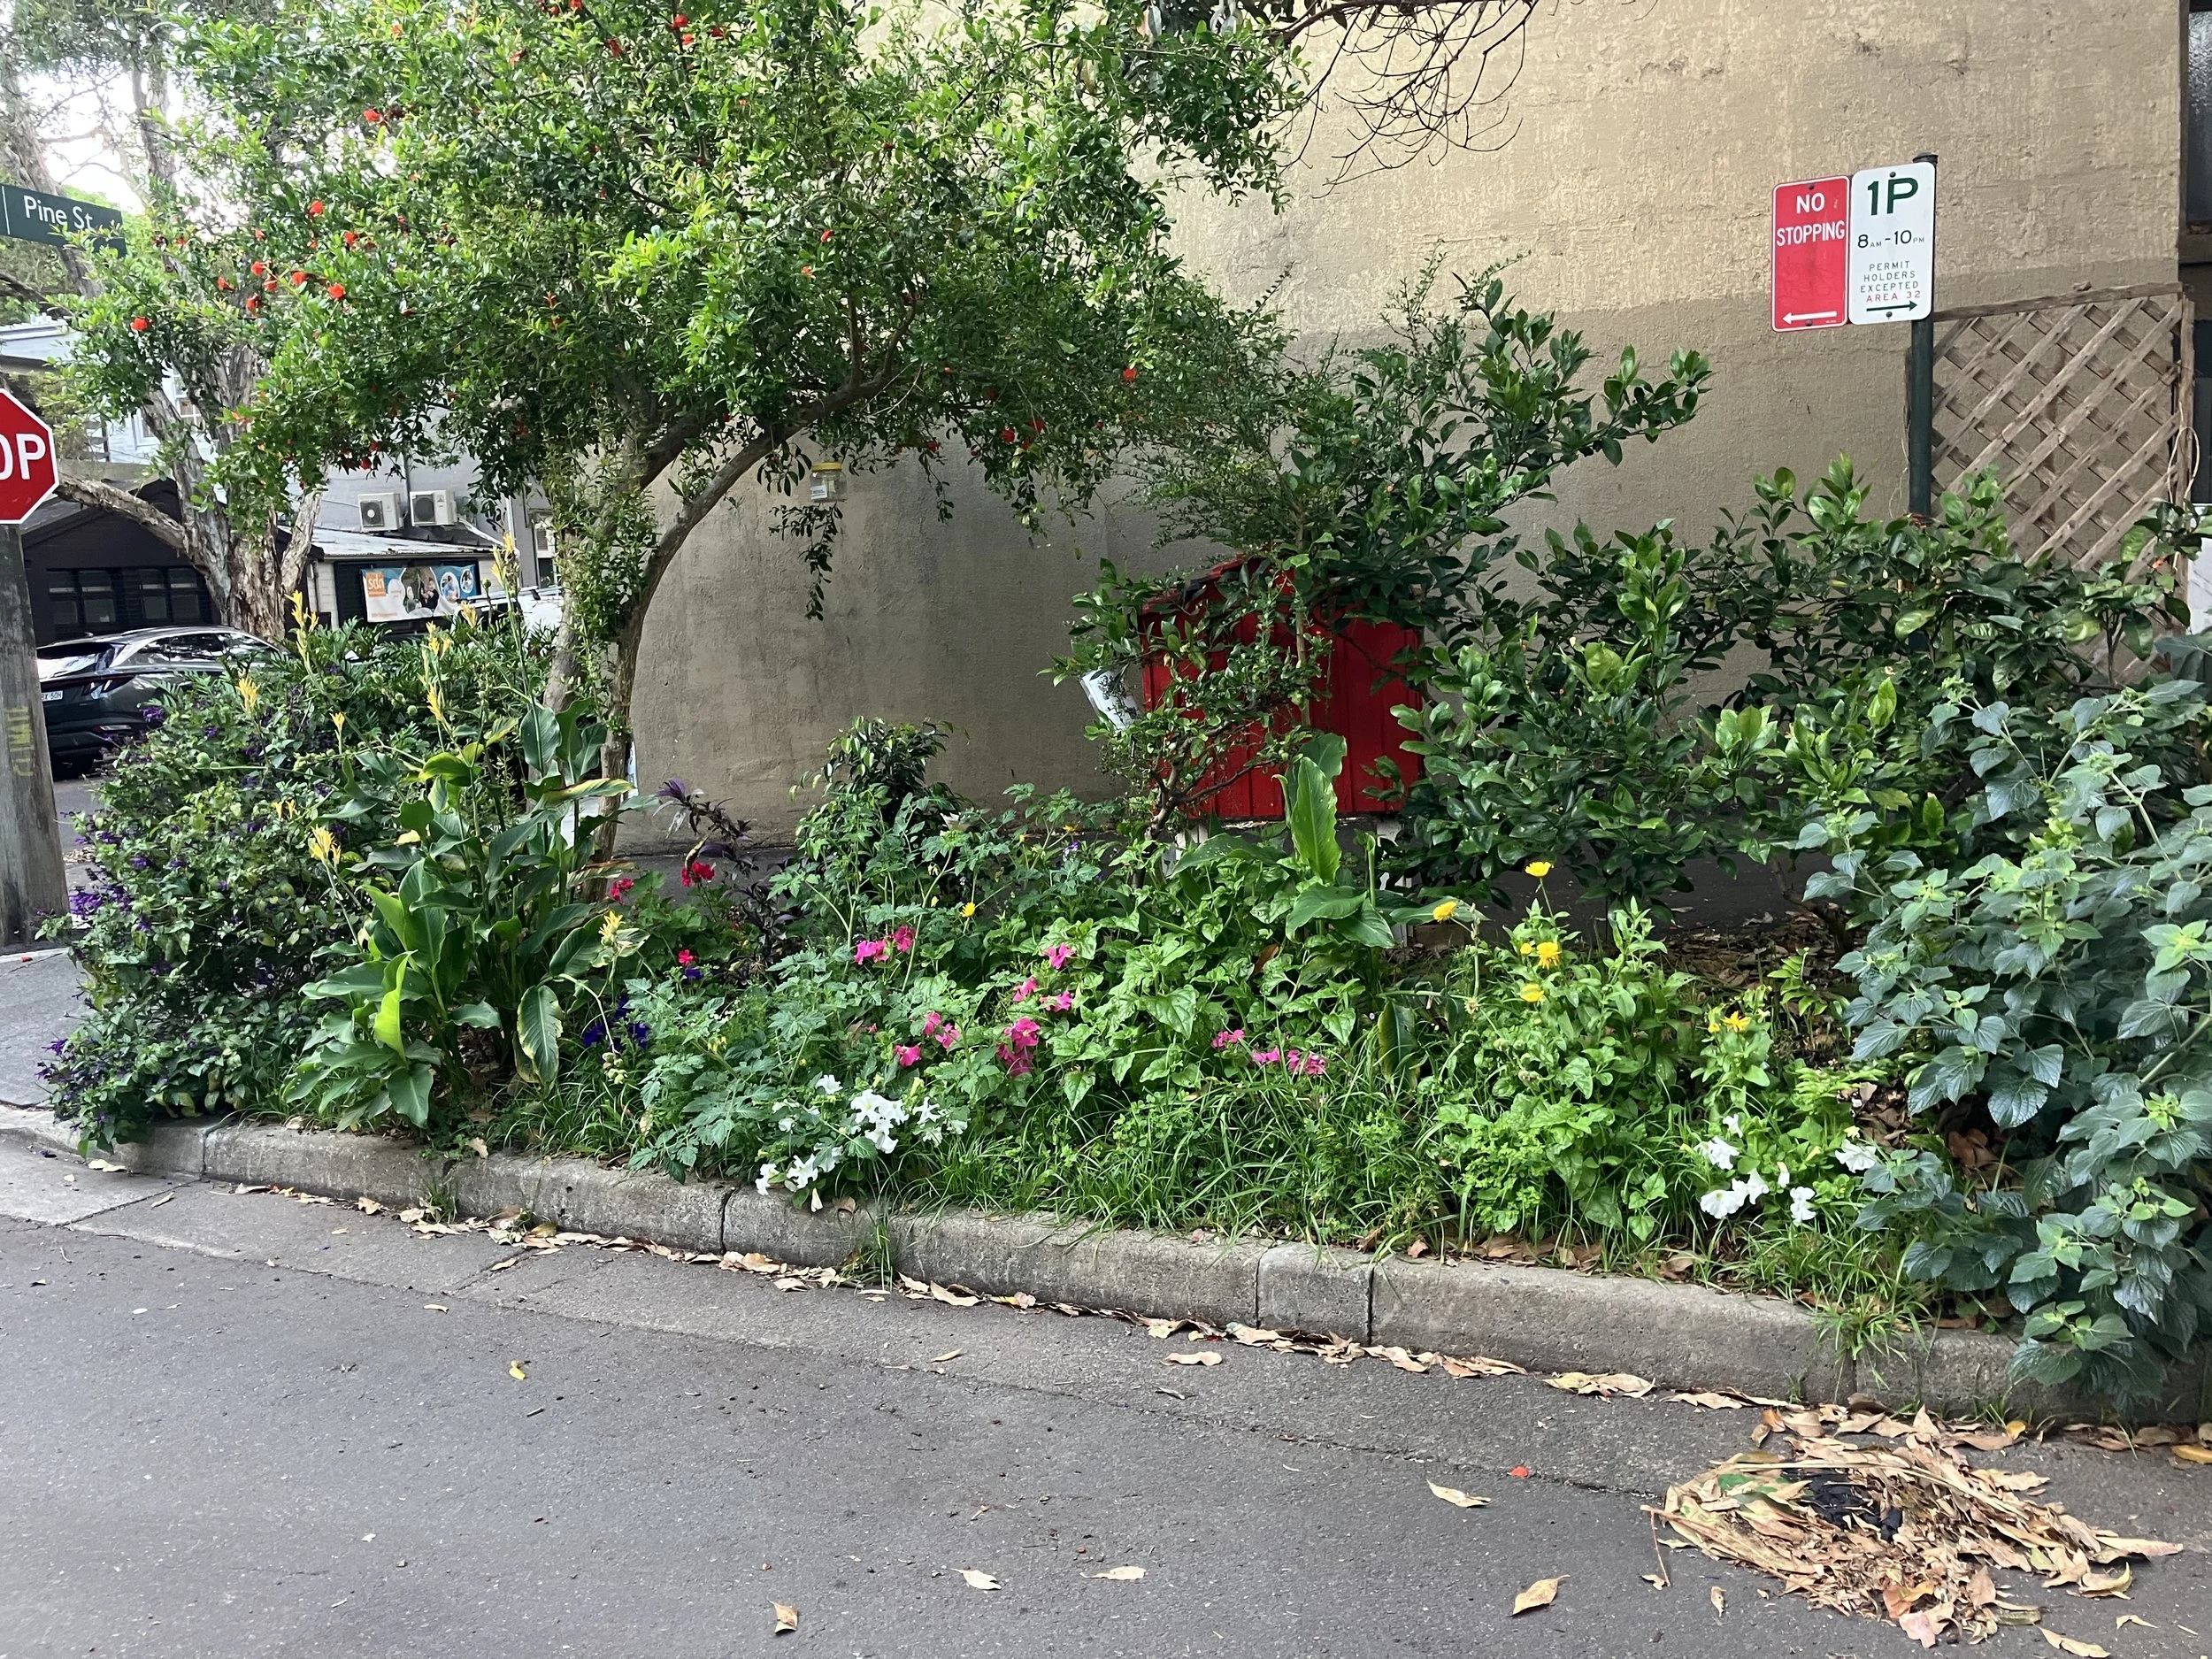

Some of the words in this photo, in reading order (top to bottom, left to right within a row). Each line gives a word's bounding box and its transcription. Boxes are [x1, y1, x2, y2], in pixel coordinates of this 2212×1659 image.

[1796, 192, 1825, 214] NO
[1867, 177, 1919, 216] 1P
[23, 195, 68, 226] Pine
[73, 205, 94, 232] St
[1776, 220, 1846, 247] STOPPING
[1869, 260, 1910, 272] PERMIT
[1863, 270, 1916, 282] HOLDERS
[1860, 280, 1919, 294] EXCEPTED
[1866, 292, 1898, 303] AREA
[1906, 290, 1921, 299] 32
